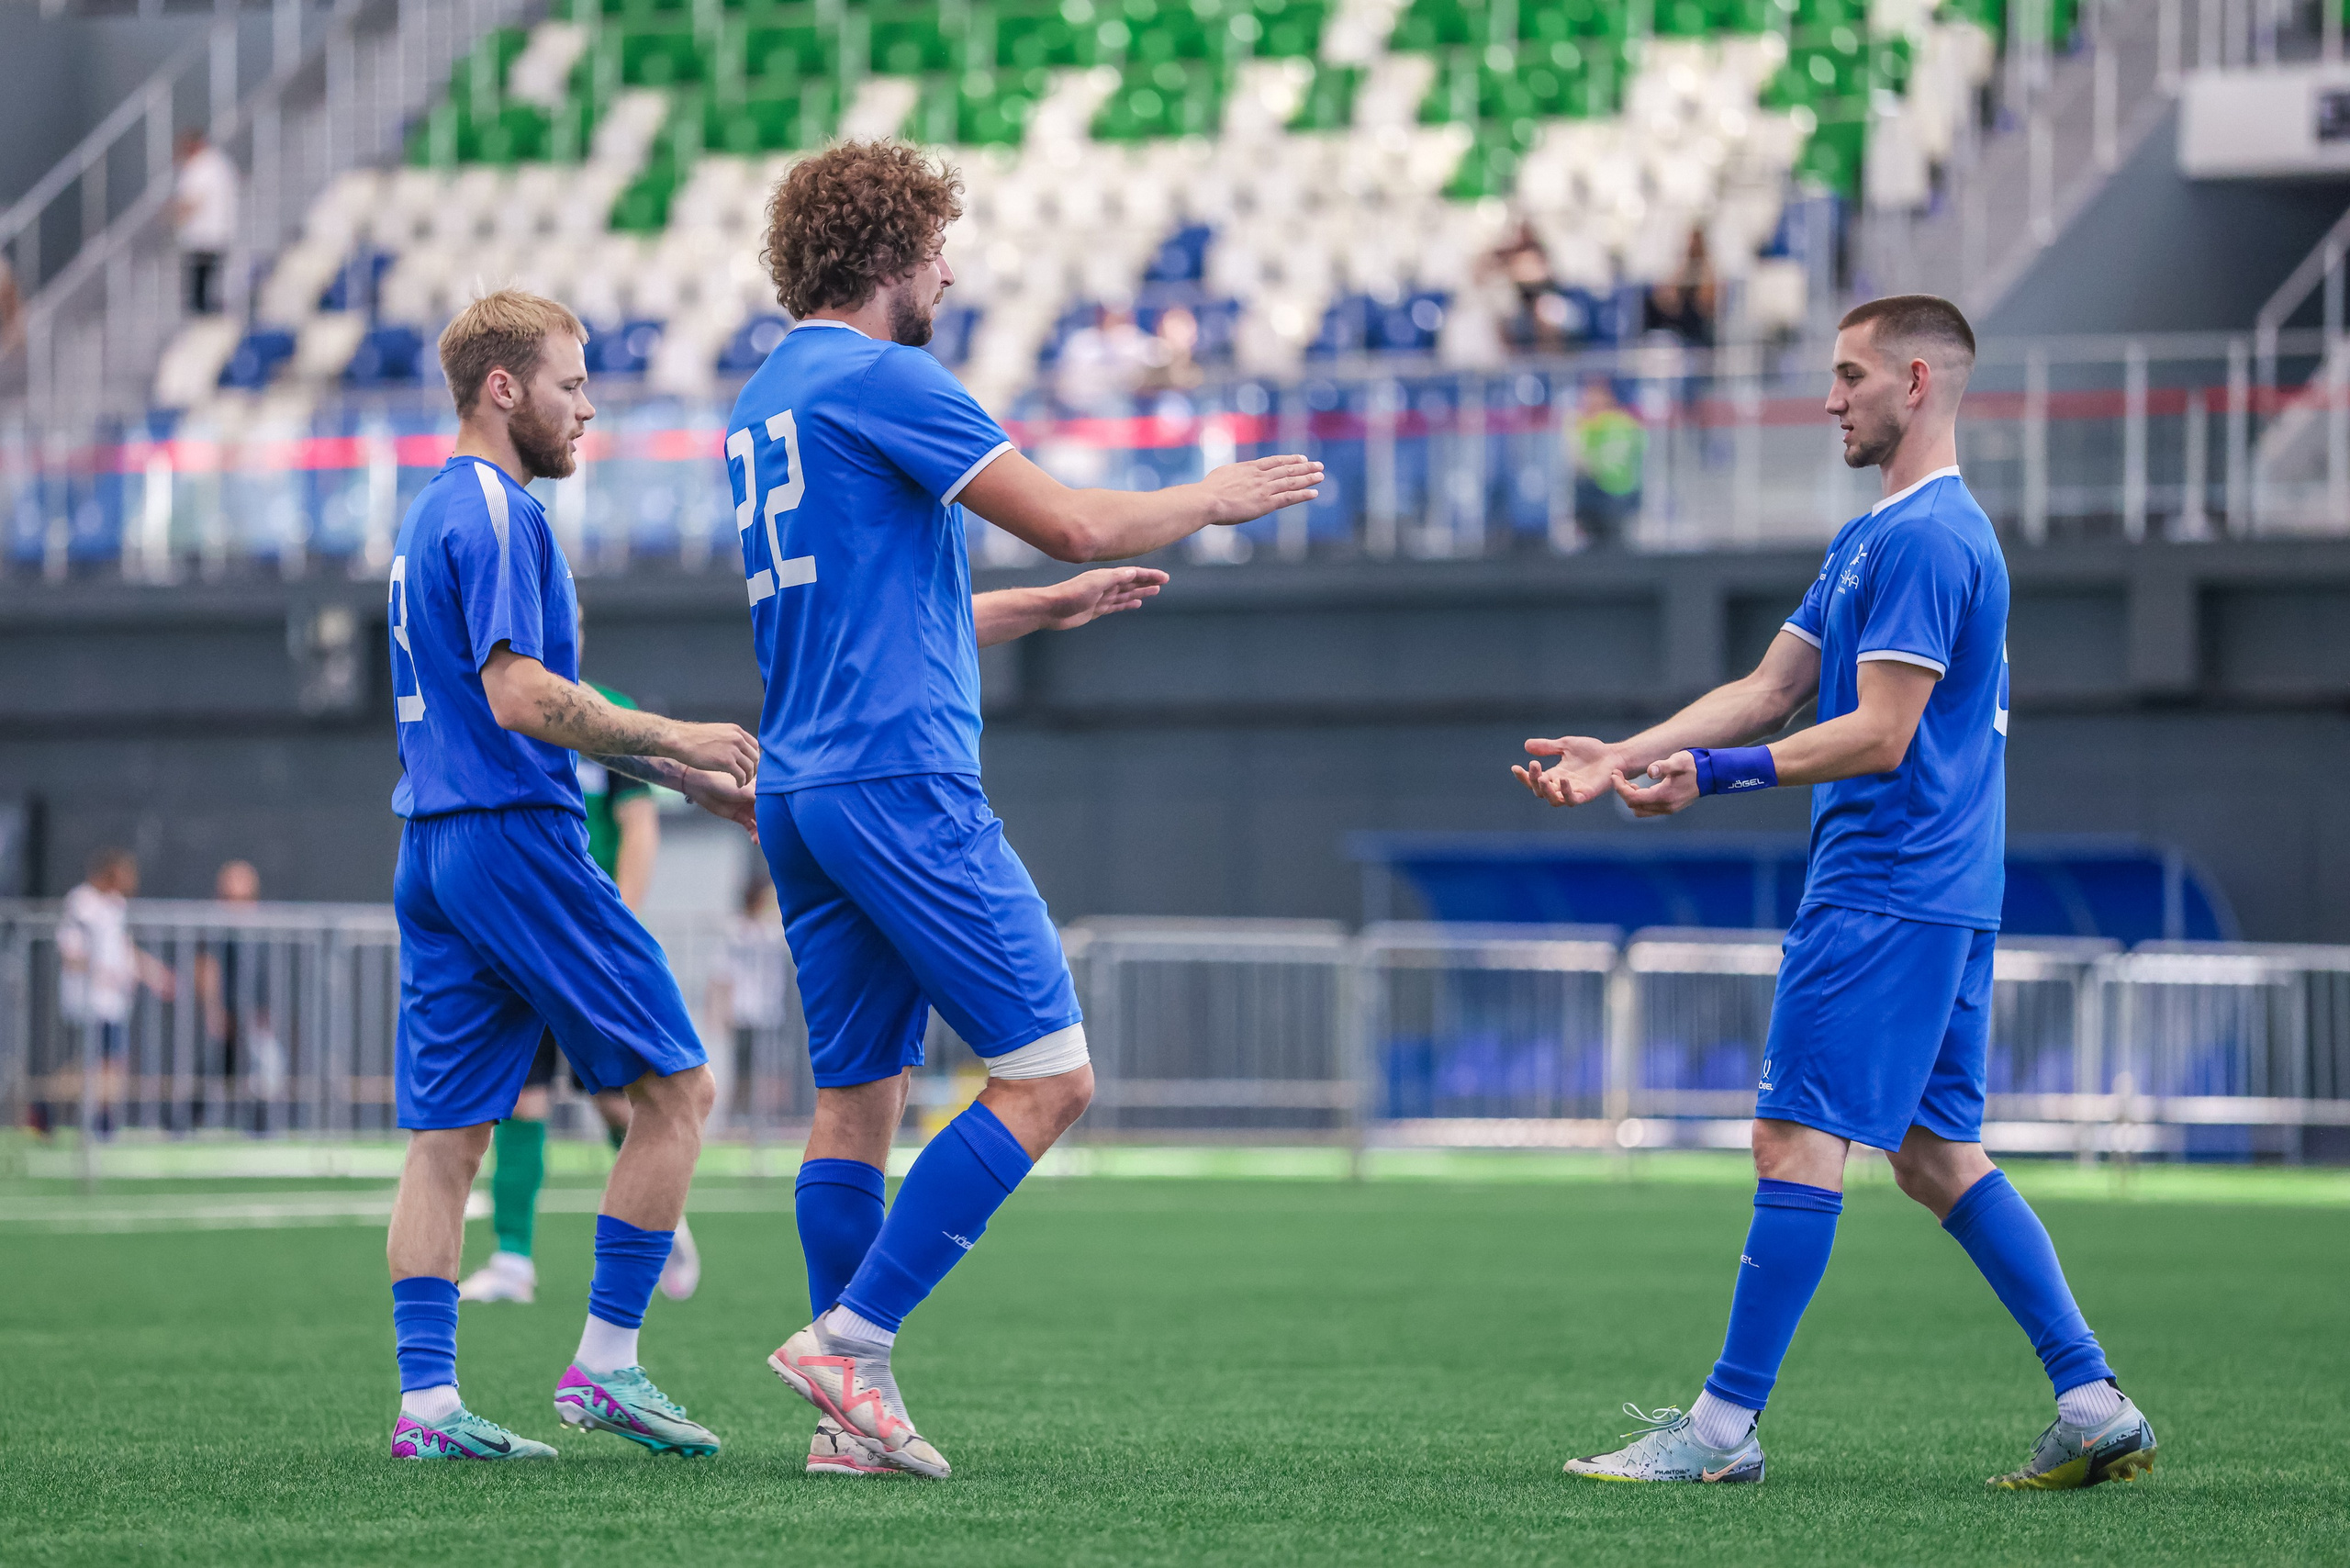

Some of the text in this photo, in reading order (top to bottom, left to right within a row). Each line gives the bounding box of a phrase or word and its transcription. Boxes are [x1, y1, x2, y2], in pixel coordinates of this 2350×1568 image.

[726, 408, 818, 608] 22
[1728, 778, 1765, 790] JÖGEL
[942, 1230, 975, 1251] JÖG
